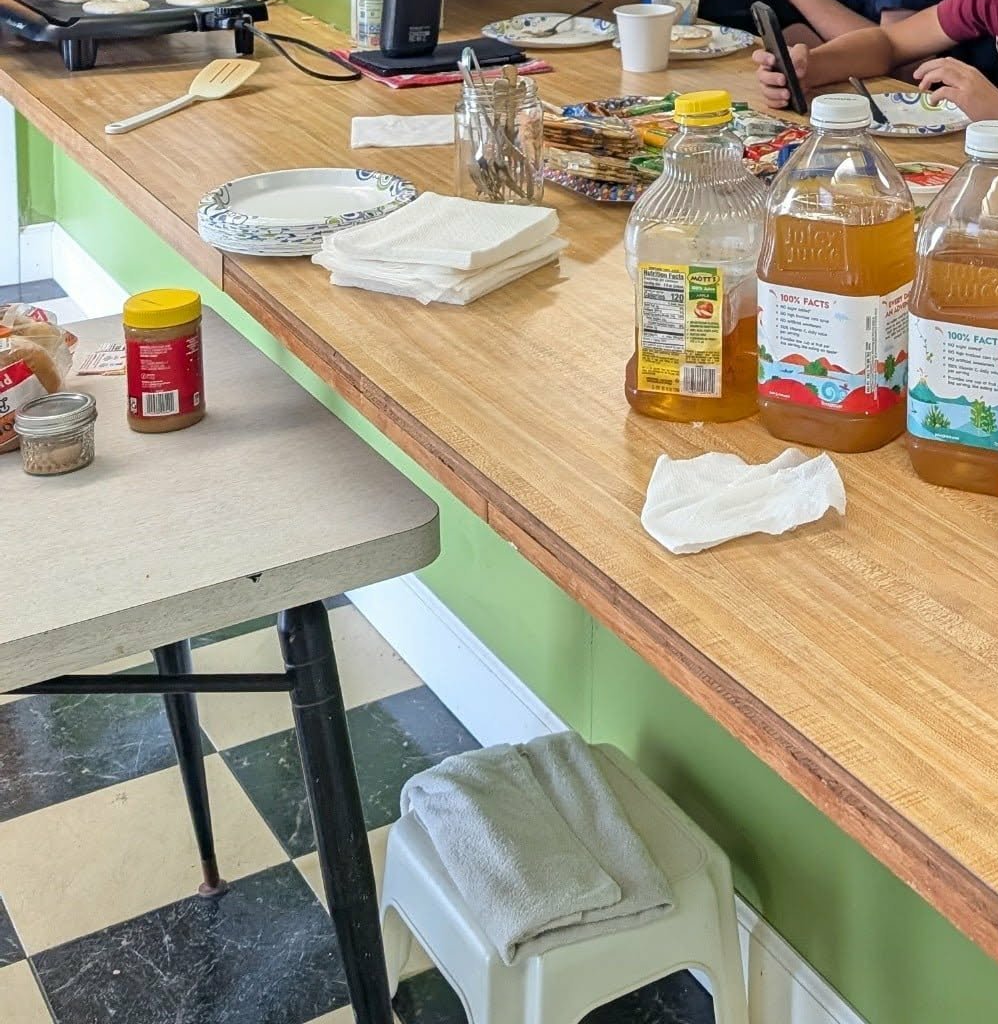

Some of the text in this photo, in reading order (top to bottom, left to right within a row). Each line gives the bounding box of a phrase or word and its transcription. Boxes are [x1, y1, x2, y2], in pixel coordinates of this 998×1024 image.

[690, 275, 716, 283] MOTT'S
[671, 293, 685, 303] 120
[780, 293, 830, 309] 100% FACTS
[948, 331, 970, 342] 100%
